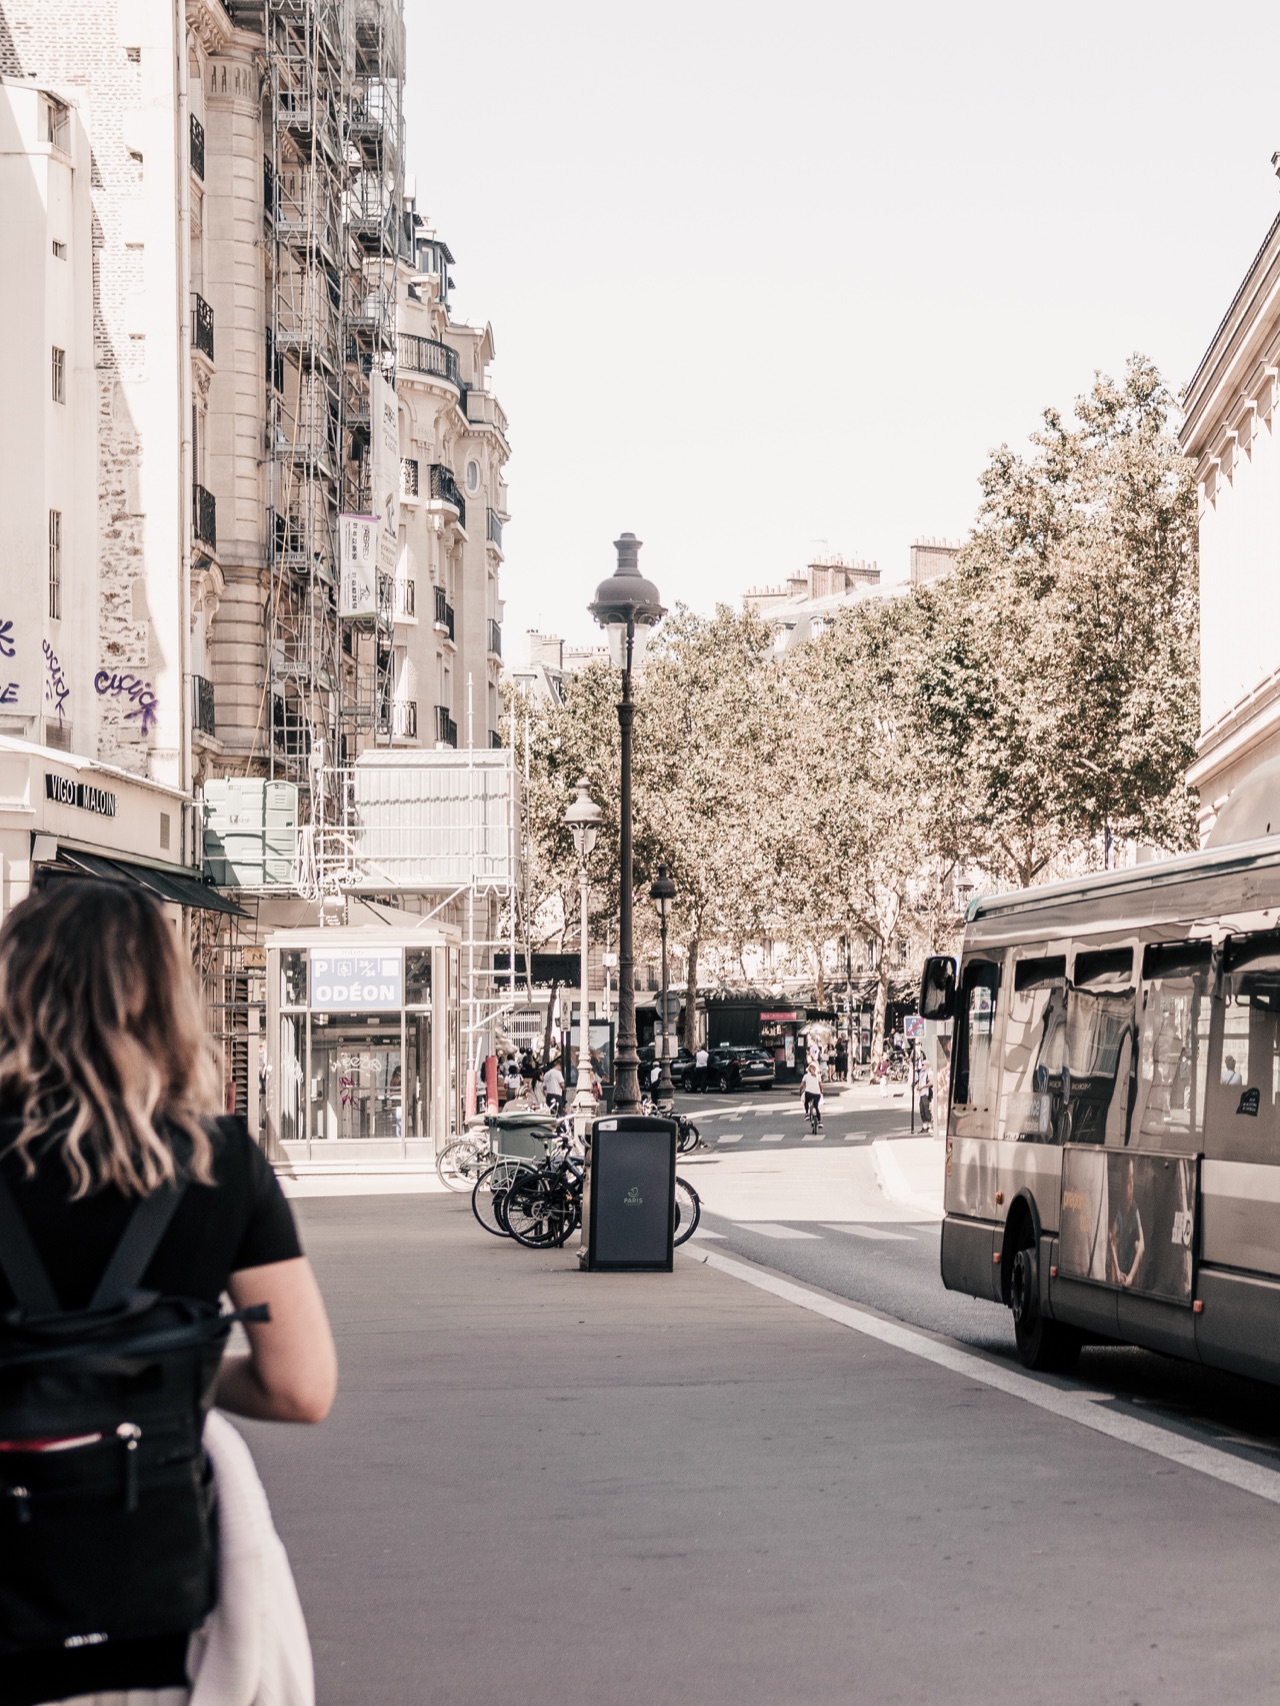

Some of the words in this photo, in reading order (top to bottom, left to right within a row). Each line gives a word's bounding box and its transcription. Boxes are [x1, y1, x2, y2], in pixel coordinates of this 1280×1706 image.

[52, 774, 79, 807] VIGOT
[315, 961, 329, 978] P
[316, 981, 395, 1002] ODÉON
